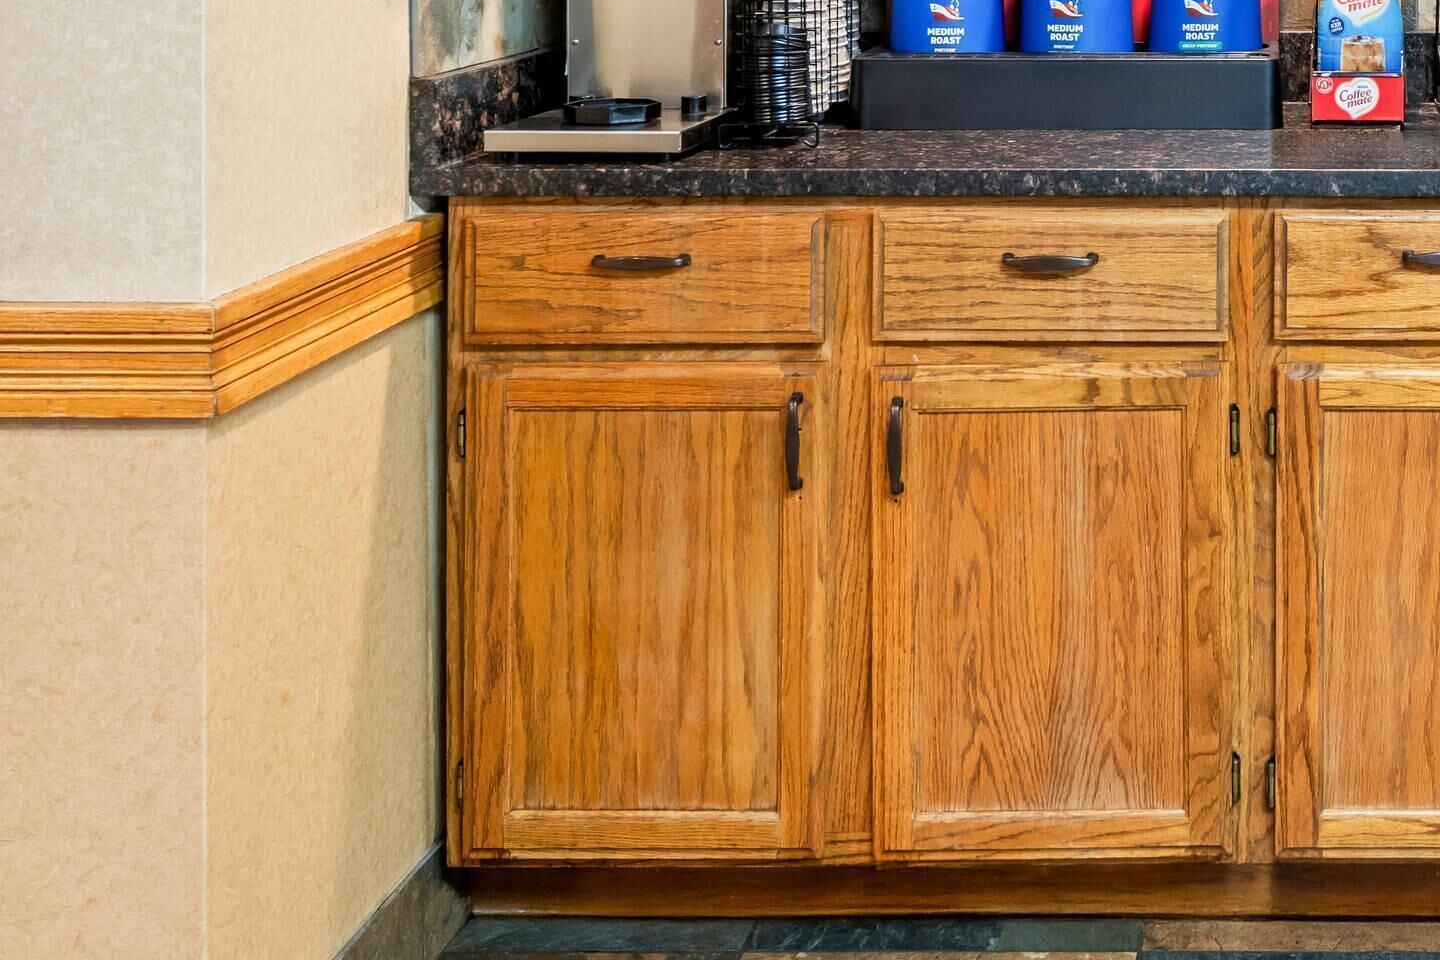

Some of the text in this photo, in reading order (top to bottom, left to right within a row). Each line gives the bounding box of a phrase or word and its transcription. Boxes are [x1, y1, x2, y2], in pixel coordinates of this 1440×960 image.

[927, 27, 965, 36] MEDIUM
[1047, 24, 1084, 33] MEDIUM
[1182, 23, 1219, 32] MEDIUM
[930, 36, 962, 45] ROAST
[1050, 33, 1080, 42] ROAST
[1185, 32, 1216, 41] ROAST
[1339, 89, 1372, 102] Coffee
[1347, 95, 1373, 108] mate
